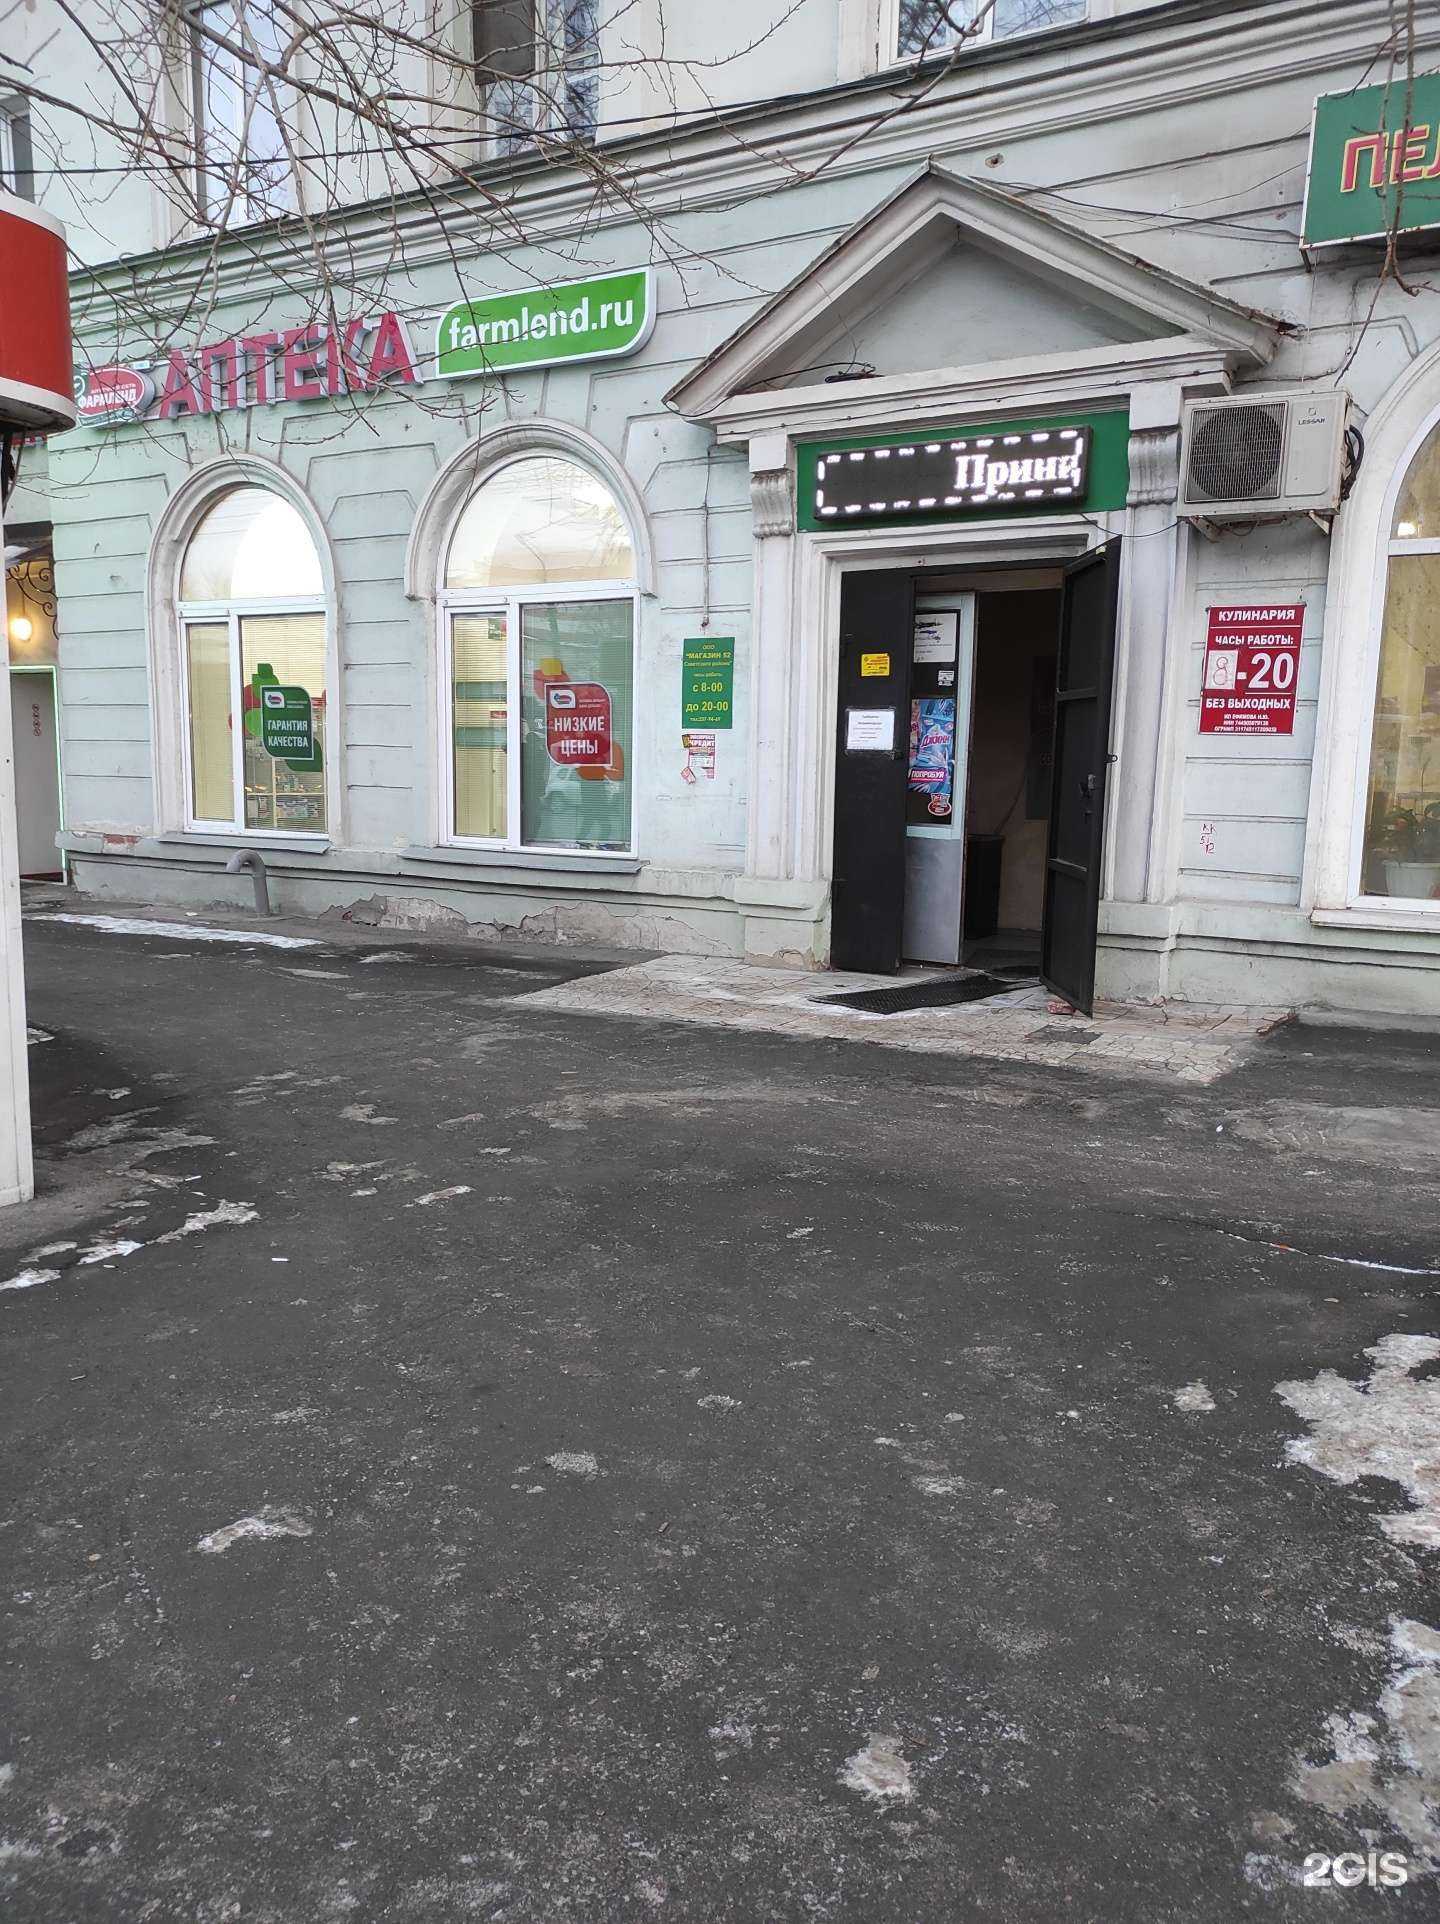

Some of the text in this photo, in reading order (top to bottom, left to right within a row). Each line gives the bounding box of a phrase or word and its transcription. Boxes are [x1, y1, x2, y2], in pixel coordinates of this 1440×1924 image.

[448, 296, 634, 350] farmlend.ru
[159, 311, 422, 420] АПТЕКА
[1218, 609, 1296, 622] КУЛИНАРИЯ
[1215, 634, 1294, 645] ЧАСЫ РАБОТЫ:
[701, 682, 723, 693] 8-00
[685, 701, 729, 713] до 20-00
[1205, 698, 1291, 711] БЕЗ ВЫХОДНЫХ
[267, 720, 308, 731] ГАРАНТИЯ
[554, 716, 605, 732] НИЗКИЕ
[267, 736, 309, 748] КАЧЕСТВА
[561, 739, 598, 757] ЦЕНЫ
